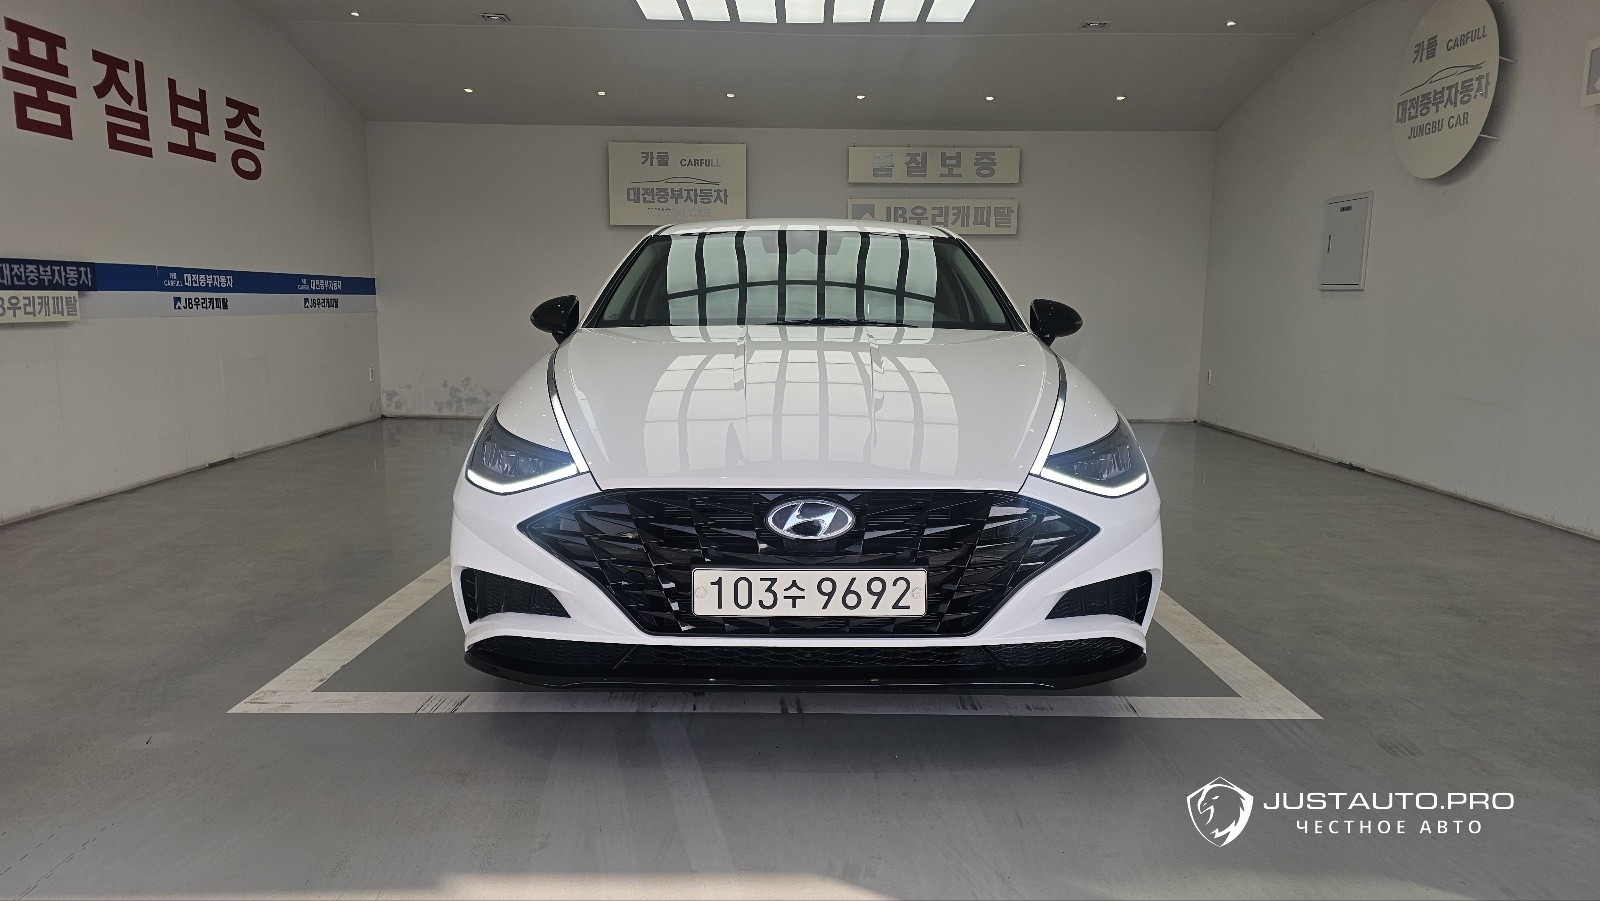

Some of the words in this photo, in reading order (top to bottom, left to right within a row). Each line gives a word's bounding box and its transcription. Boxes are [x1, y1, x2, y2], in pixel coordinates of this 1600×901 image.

[1446, 25, 1488, 52] CARFULL
[1, 15, 265, 181] 품질보증
[1396, 72, 1491, 124] 대전중부자동차
[1407, 118, 1444, 140] JUNGBU
[1447, 112, 1469, 130] CAR
[680, 158, 722, 168] CARFULL
[872, 151, 998, 178] 품질보증
[626, 187, 729, 205] 대전중부자동차
[184, 273, 234, 288] 대전중부자동차
[710, 576, 806, 610] 103수
[816, 576, 911, 610] 9692
